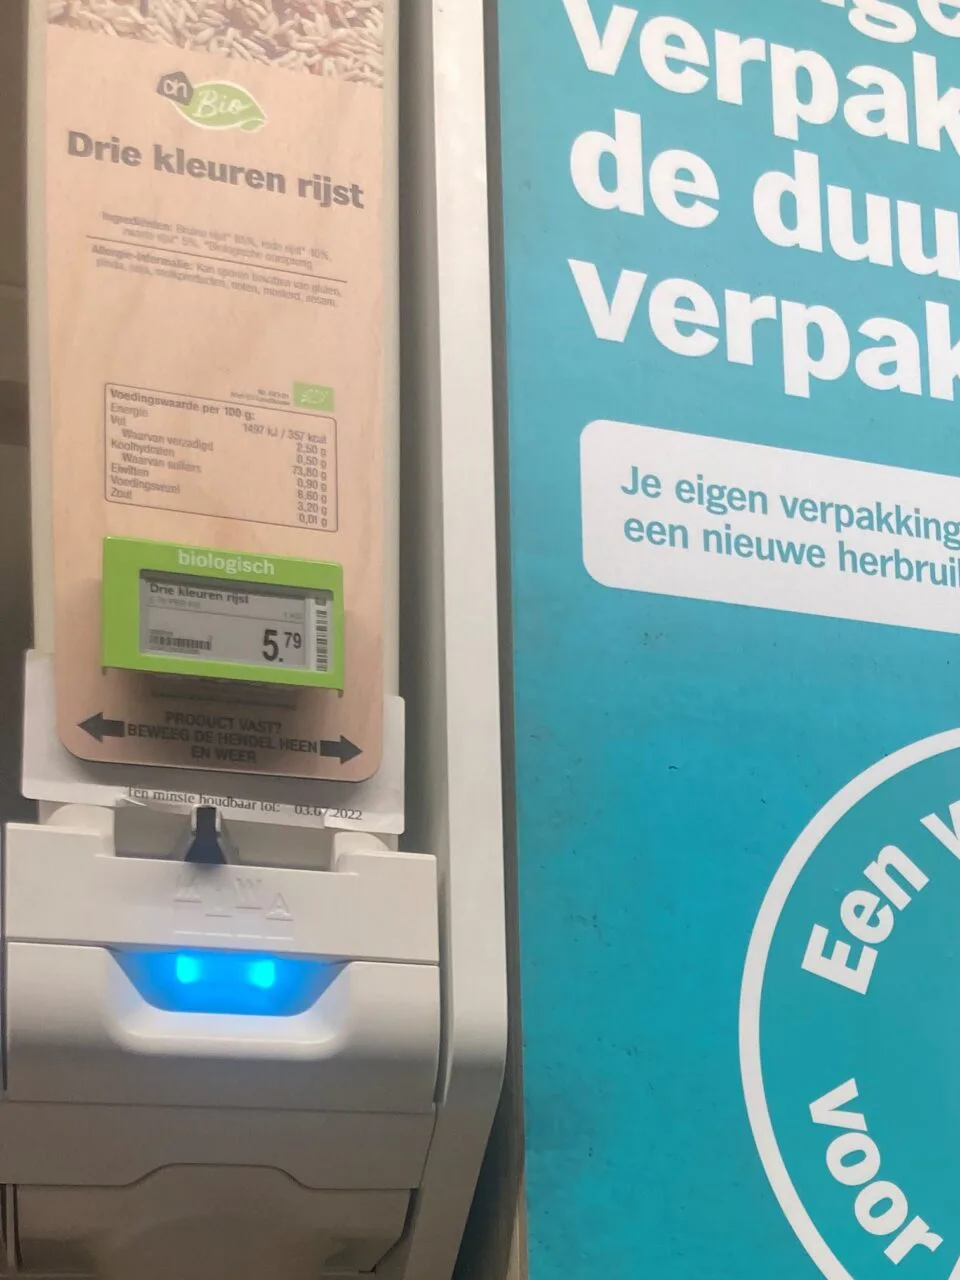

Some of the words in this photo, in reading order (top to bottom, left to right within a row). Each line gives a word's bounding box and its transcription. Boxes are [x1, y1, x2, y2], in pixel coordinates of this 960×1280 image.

[192, 88, 252, 118] Bio
[67, 130, 142, 167] Drie
[153, 143, 287, 194] kleuren
[297, 173, 365, 209] rijst
[569, 109, 720, 229] de
[202, 404, 220, 415] per
[620, 465, 663, 502] Je
[674, 474, 769, 518] eigen
[623, 513, 689, 552] een
[702, 524, 827, 573] nieuwe
[177, 549, 275, 577] biologisch
[150, 583, 175, 597] Drie
[177, 584, 224, 602] kleuren
[226, 590, 250, 606] rijst
[127, 724, 190, 743] BEWEEG
[194, 729, 214, 744] DE
[217, 732, 276, 750] HENDEL
[279, 736, 318, 754] HEEN
[191, 744, 213, 760] EN
[215, 746, 257, 764] WEER
[199, 793, 257, 812] houdbaar
[801, 844, 930, 996] Een
[808, 1076, 944, 1266] voor
